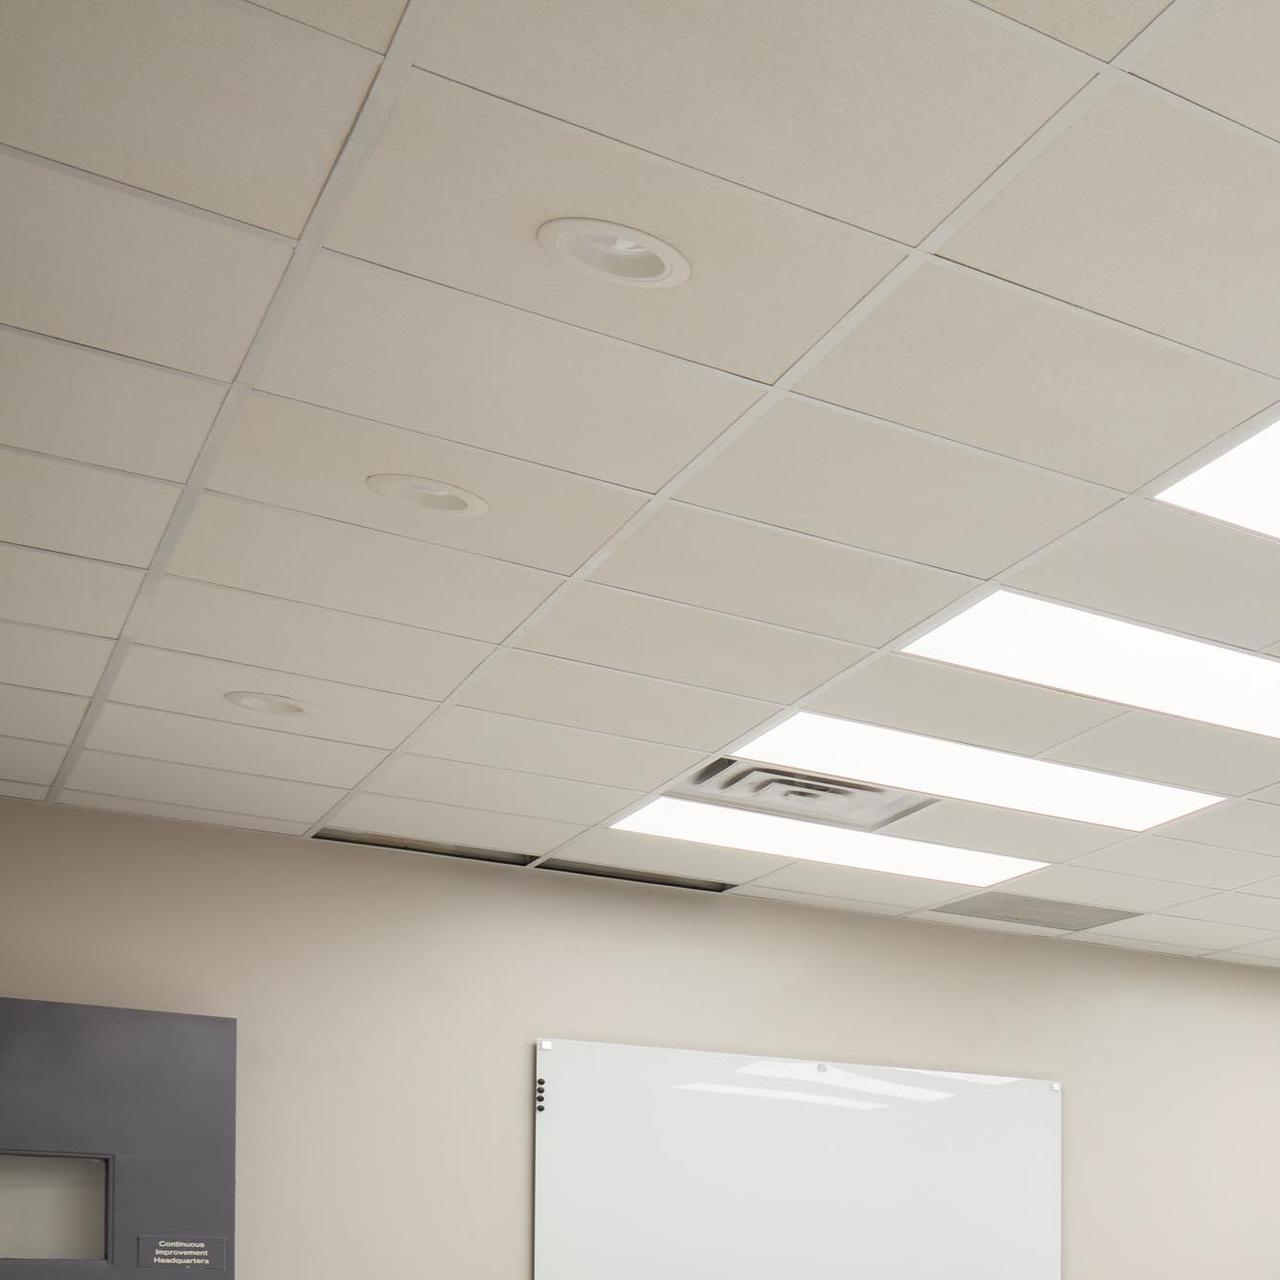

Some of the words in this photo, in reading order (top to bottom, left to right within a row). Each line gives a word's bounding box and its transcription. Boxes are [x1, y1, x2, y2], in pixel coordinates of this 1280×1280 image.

[158, 1240, 205, 1248] Continuous
[155, 1248, 208, 1256] Improvement
[153, 1257, 210, 1265] Headquarters
